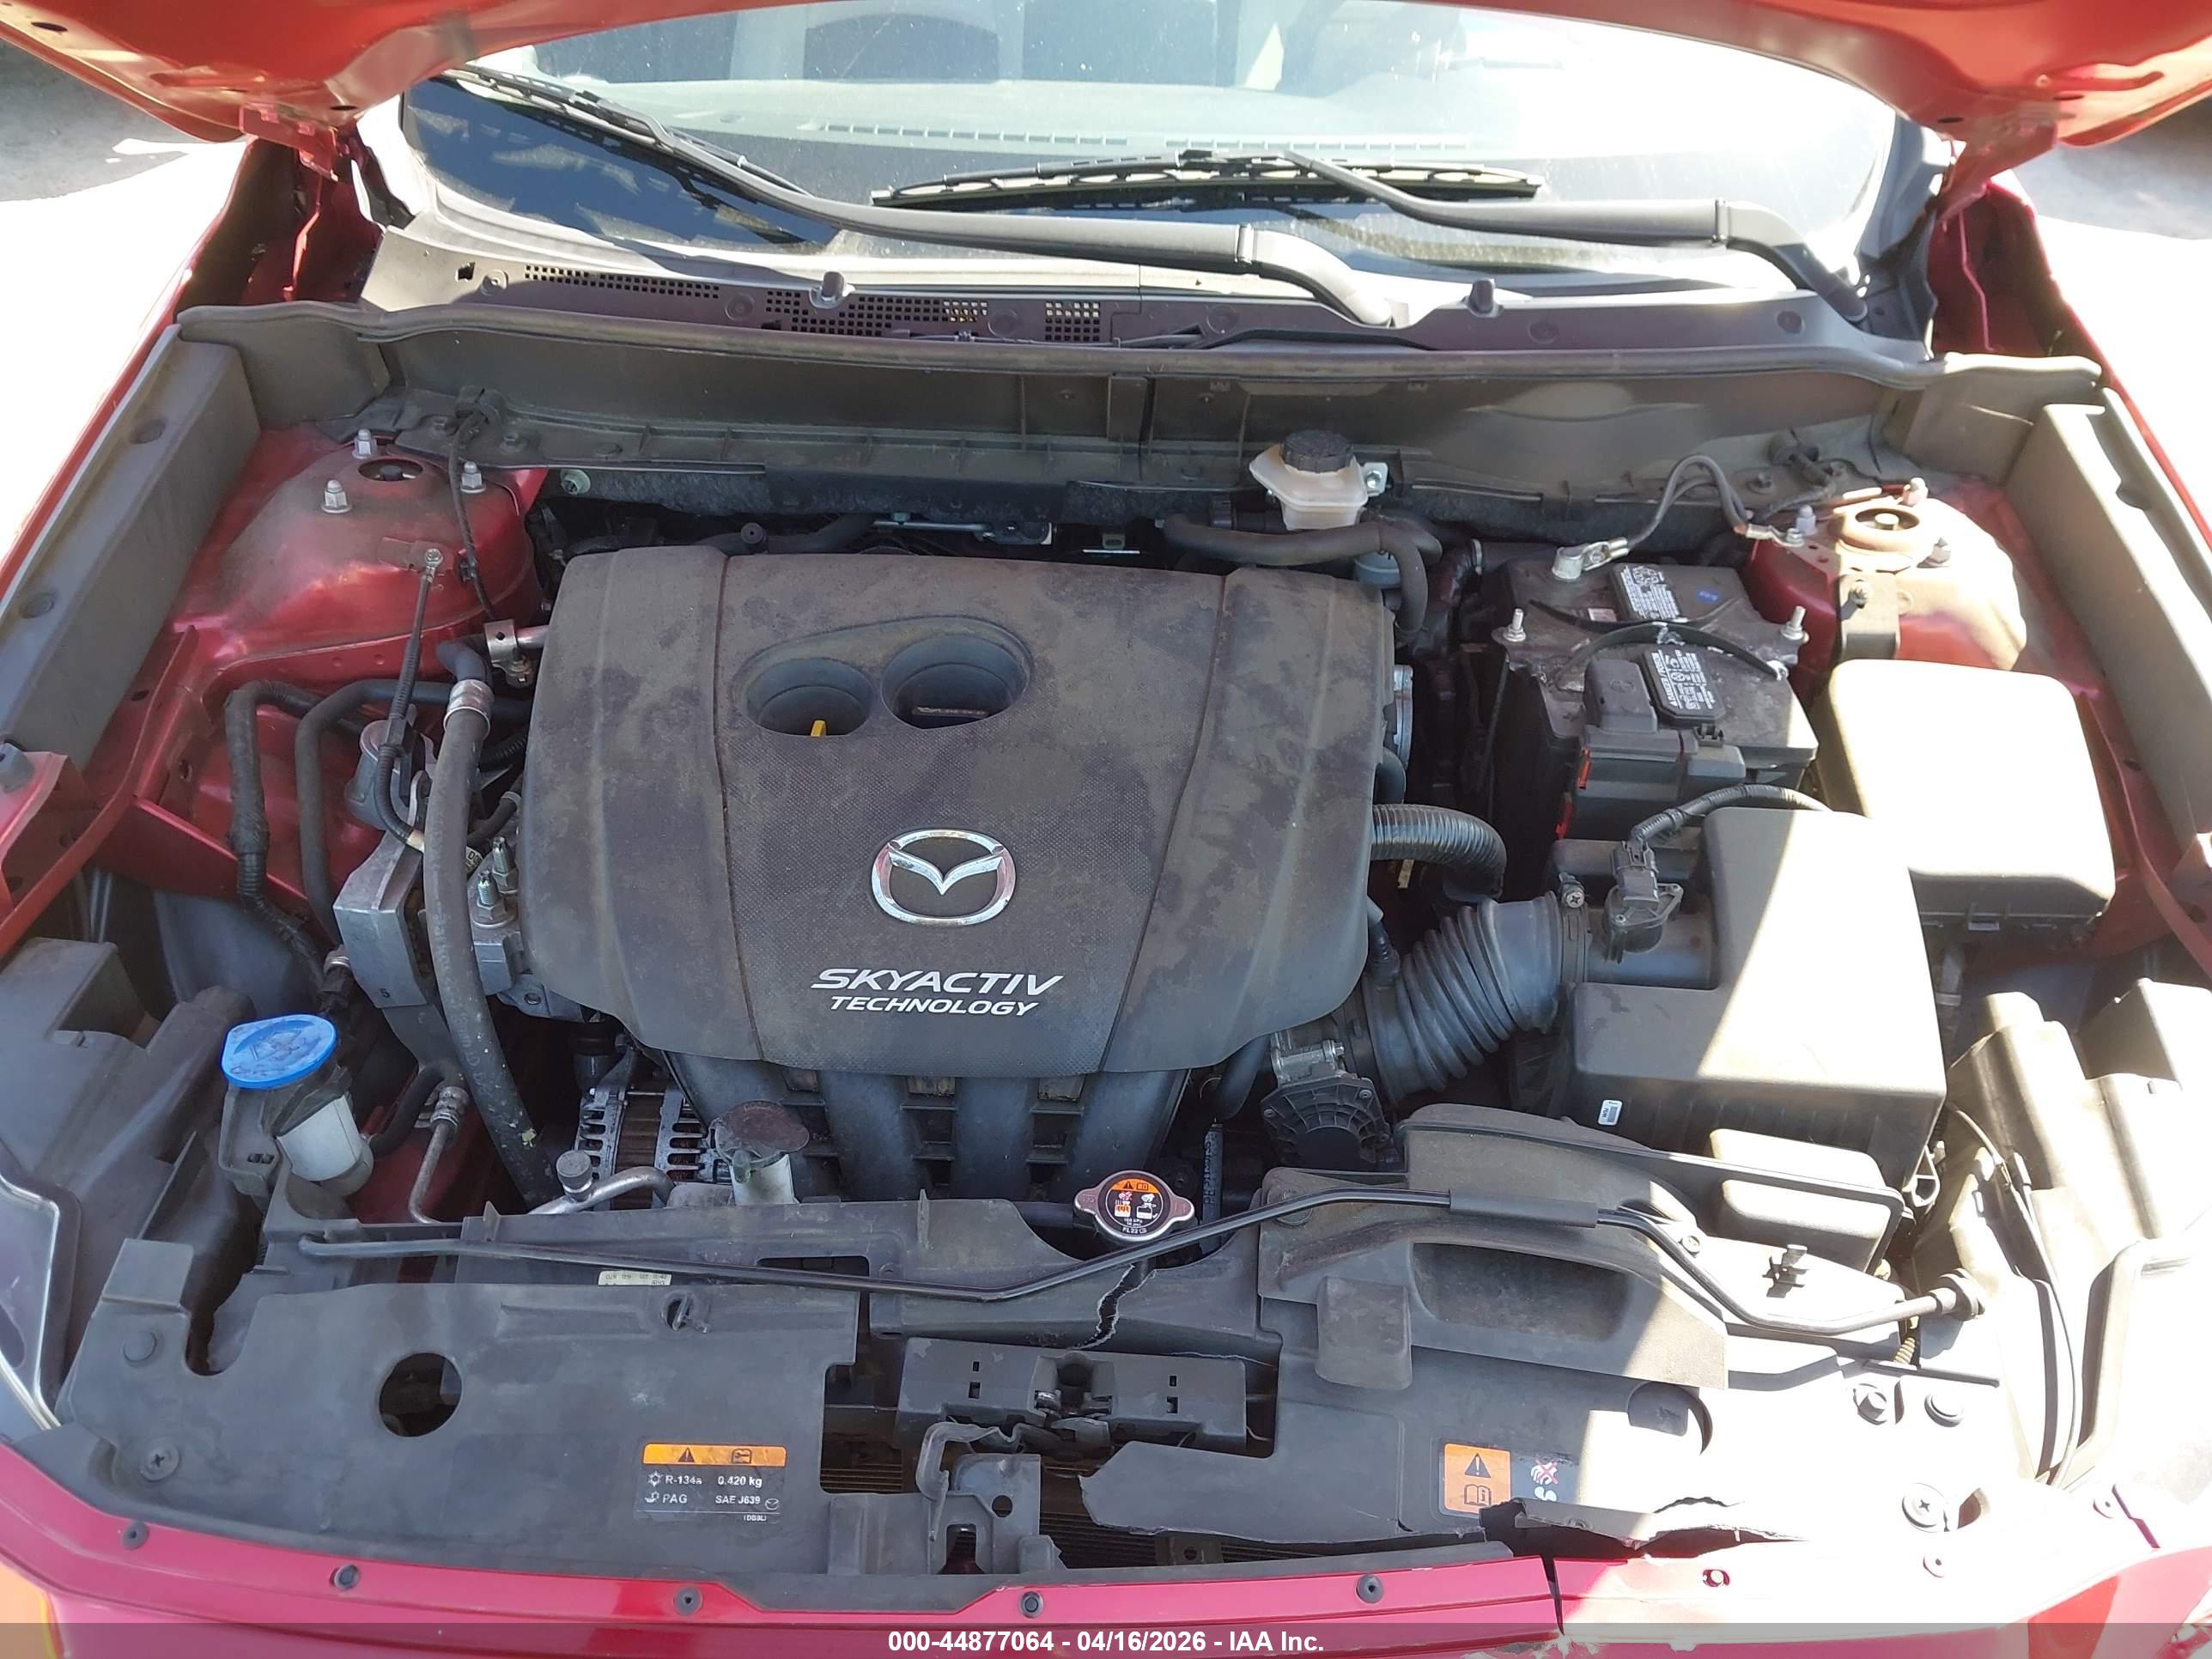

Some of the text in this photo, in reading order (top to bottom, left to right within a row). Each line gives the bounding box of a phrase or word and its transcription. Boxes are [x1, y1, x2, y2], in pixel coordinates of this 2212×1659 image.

[810, 968, 1064, 996] SKYACTIV
[830, 995, 1040, 1017] TECHNOLOGY
[665, 1474, 763, 1488] R-134a 0.420 kg
[662, 1494, 761, 1505] PAG SAE J639
